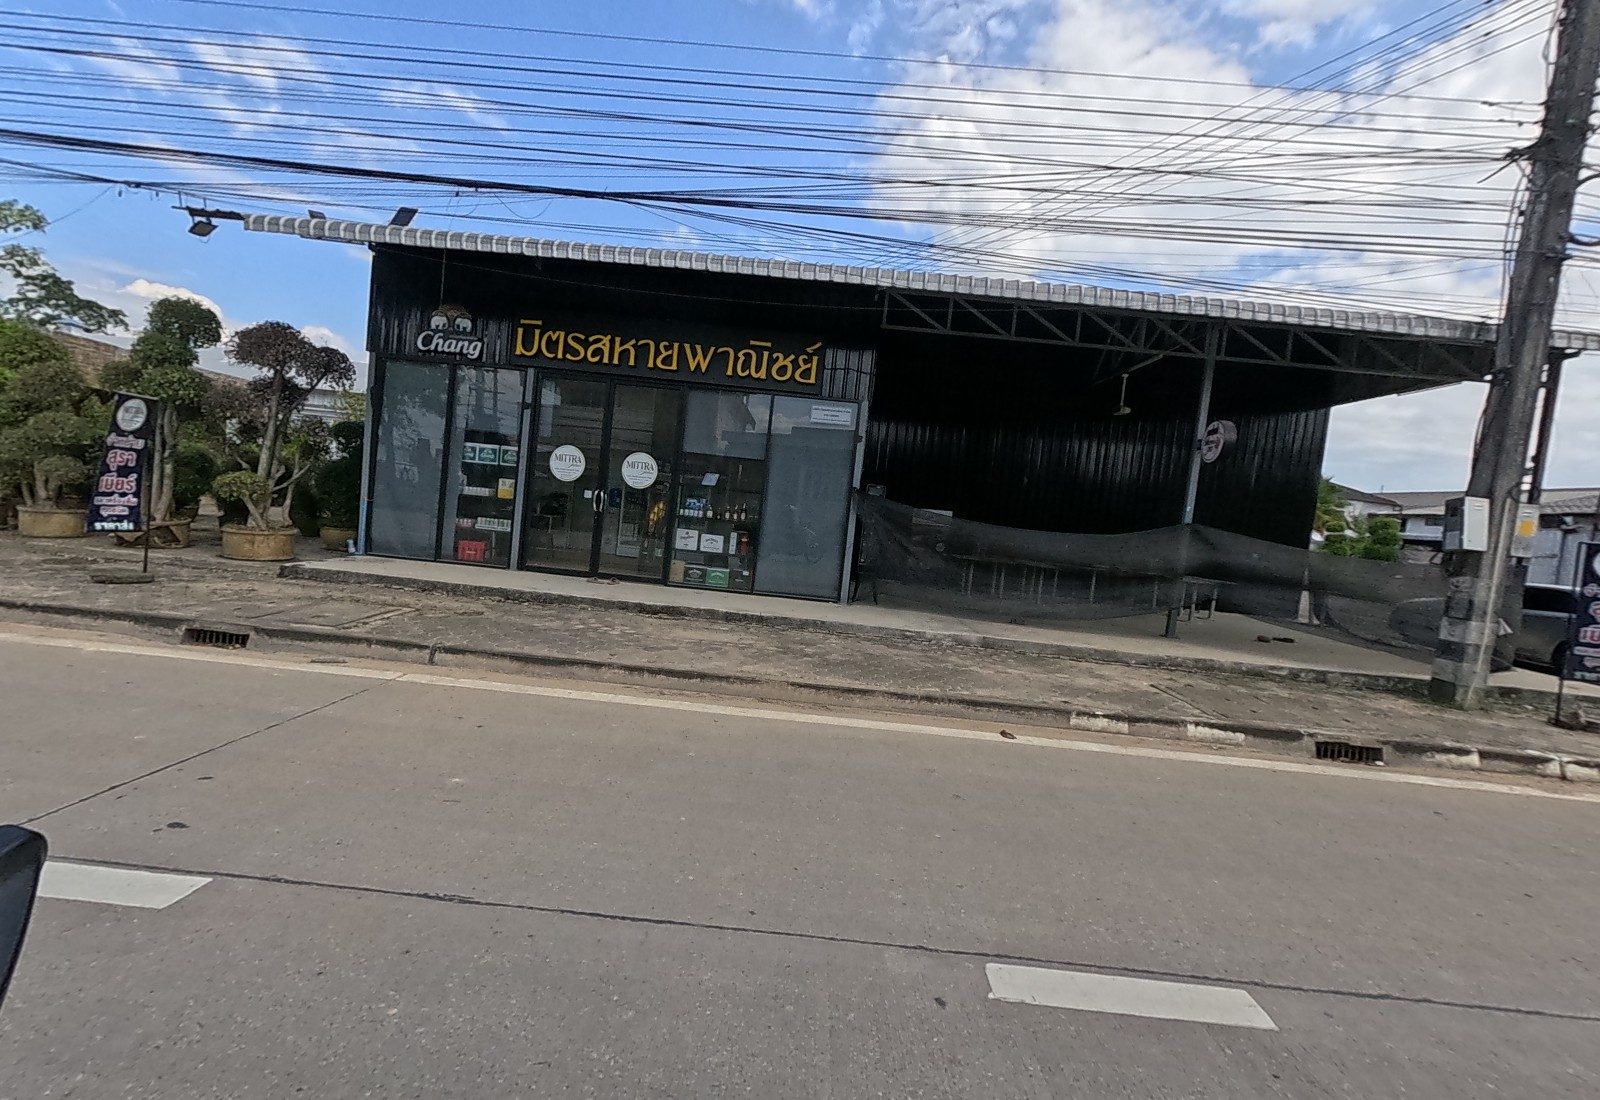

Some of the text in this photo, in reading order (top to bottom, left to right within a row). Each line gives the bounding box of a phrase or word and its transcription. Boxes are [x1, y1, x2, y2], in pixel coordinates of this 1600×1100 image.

[416, 330, 483, 359] Chang
[514, 319, 822, 385] มิตรสหายพาณิชย์
[106, 449, 137, 471] สุรา
[554, 452, 582, 464] MITTRA
[625, 460, 655, 472] MITTRA
[98, 472, 138, 493] เบียร์
